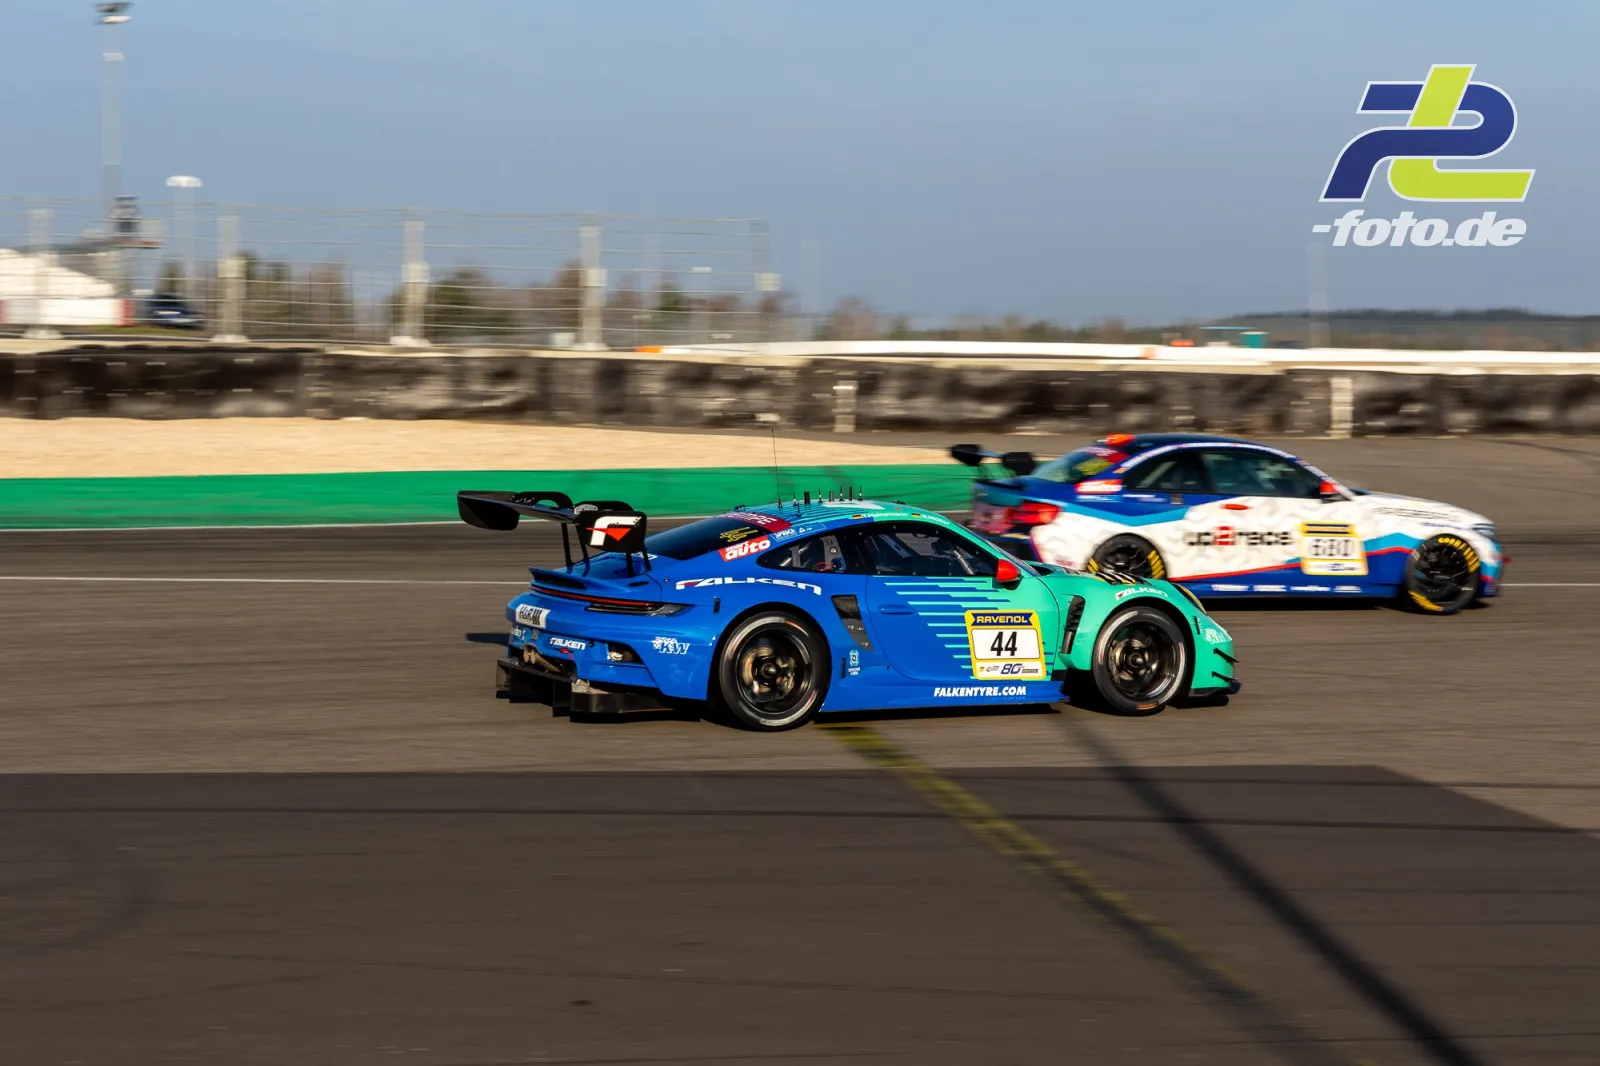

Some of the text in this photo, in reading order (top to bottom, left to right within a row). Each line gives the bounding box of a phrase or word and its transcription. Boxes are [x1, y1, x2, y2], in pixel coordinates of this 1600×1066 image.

[725, 539, 771, 561] auto
[675, 576, 822, 596] FALKEN
[1115, 587, 1169, 602] FALKEN
[976, 615, 1028, 624] RAVENOL
[549, 637, 587, 651] FALKEN
[990, 631, 1018, 657] 44
[933, 685, 1027, 698] FALKENTYRE.COM
